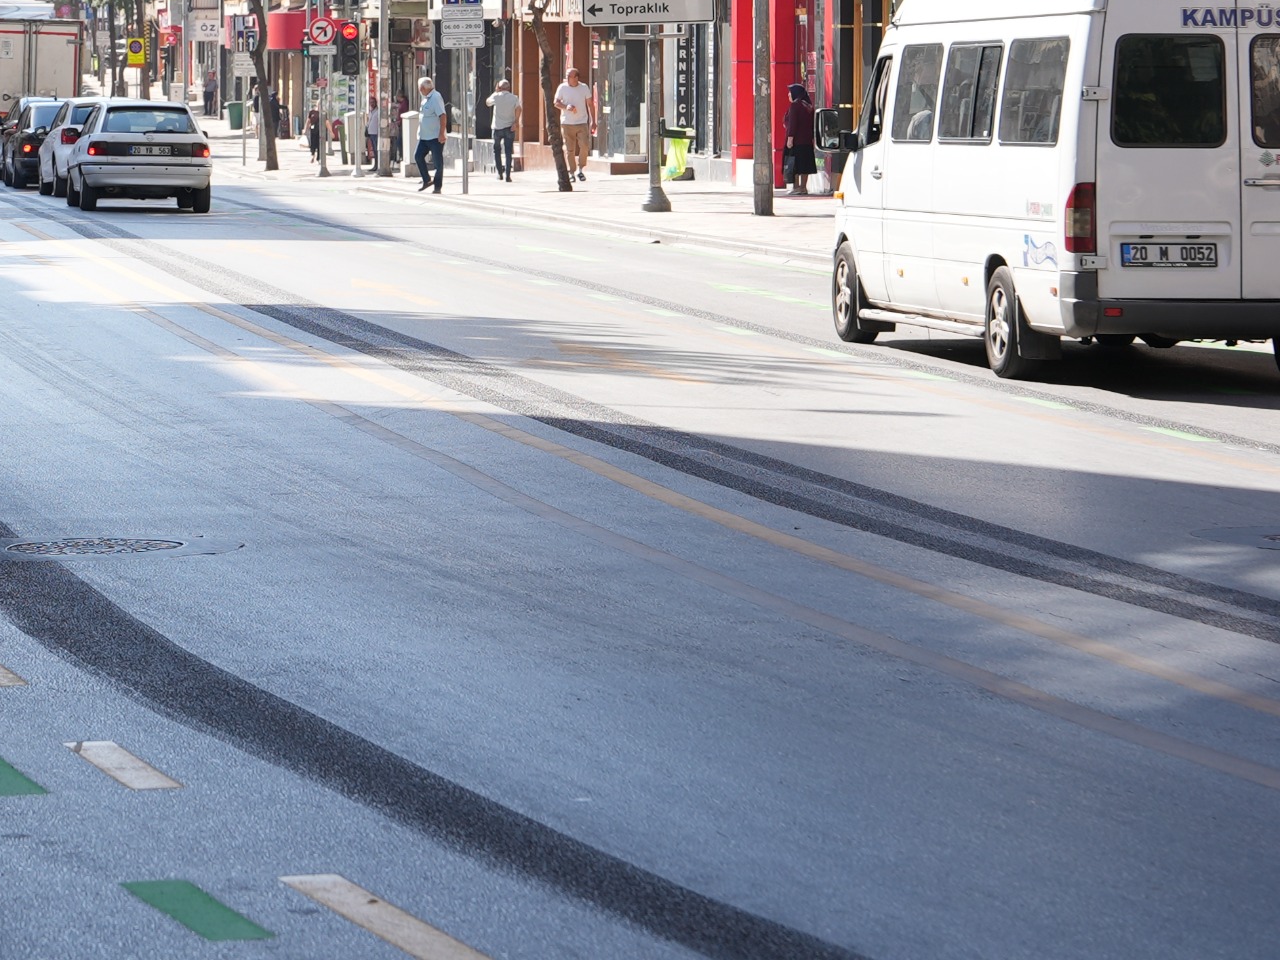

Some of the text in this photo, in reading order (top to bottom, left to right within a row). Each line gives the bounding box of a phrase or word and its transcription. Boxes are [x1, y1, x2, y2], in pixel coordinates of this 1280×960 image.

[609, 3, 669, 16] Topraklık
[133, 146, 141, 154] 20
[1131, 246, 1214, 261] 20 M 0052
